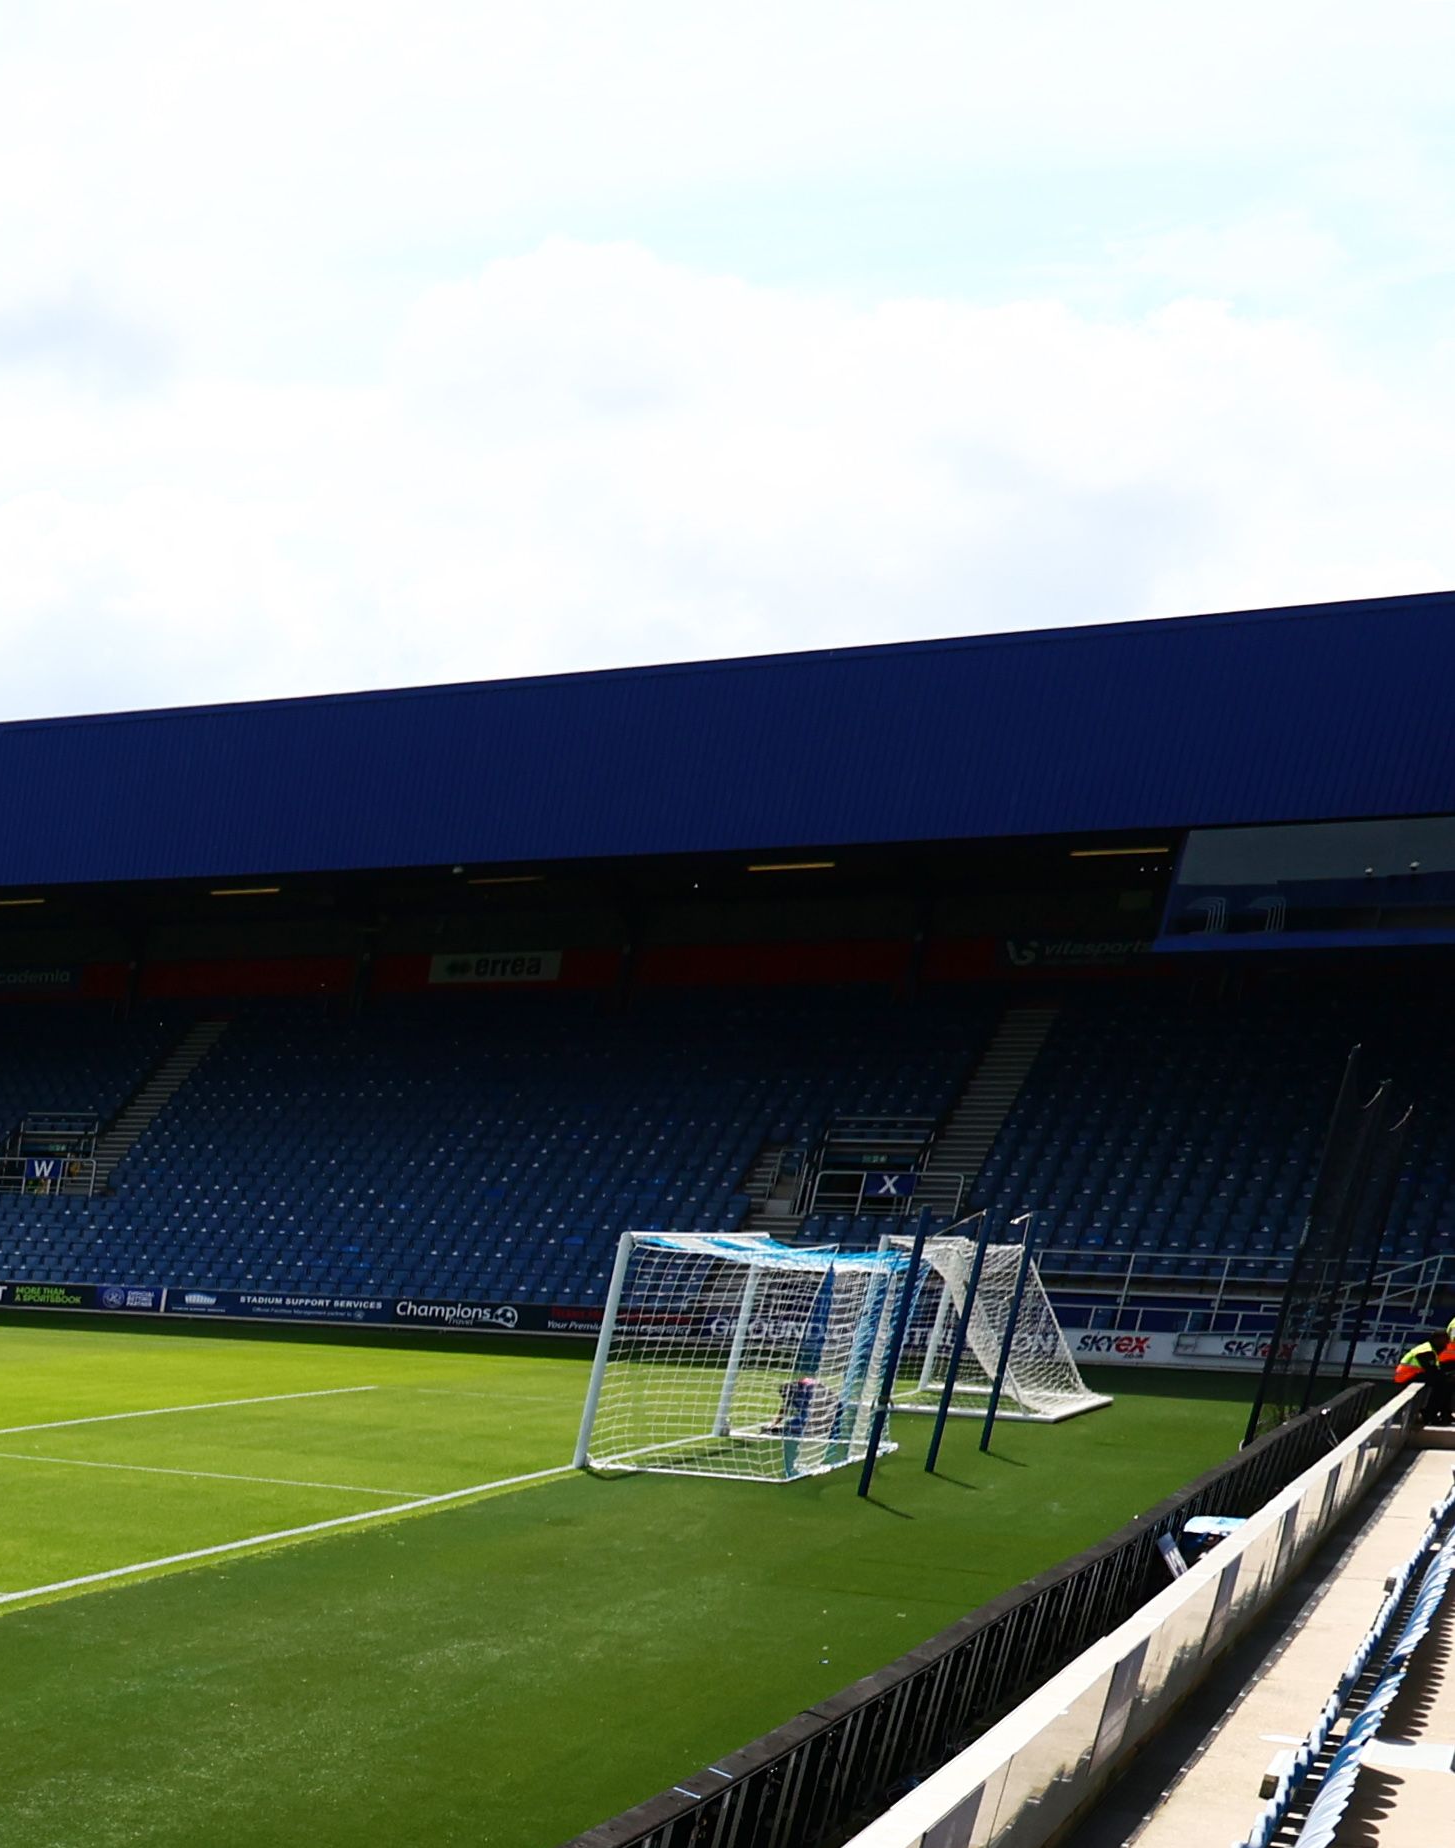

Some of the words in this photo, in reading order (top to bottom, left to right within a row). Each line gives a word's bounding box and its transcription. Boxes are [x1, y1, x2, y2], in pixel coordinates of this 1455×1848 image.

[34, 1160, 55, 1178] W
[879, 1175, 899, 1195] X
[16, 1286, 43, 1295] MORE
[44, 1287, 66, 1295] THAN
[22, 1294, 82, 1304] SPORTSBOOK
[240, 1295, 284, 1305] STADIUM
[285, 1297, 330, 1308] SUPPORT
[334, 1299, 383, 1310] SERVICES
[396, 1300, 491, 1322] Champions
[547, 1320, 569, 1330] Your
